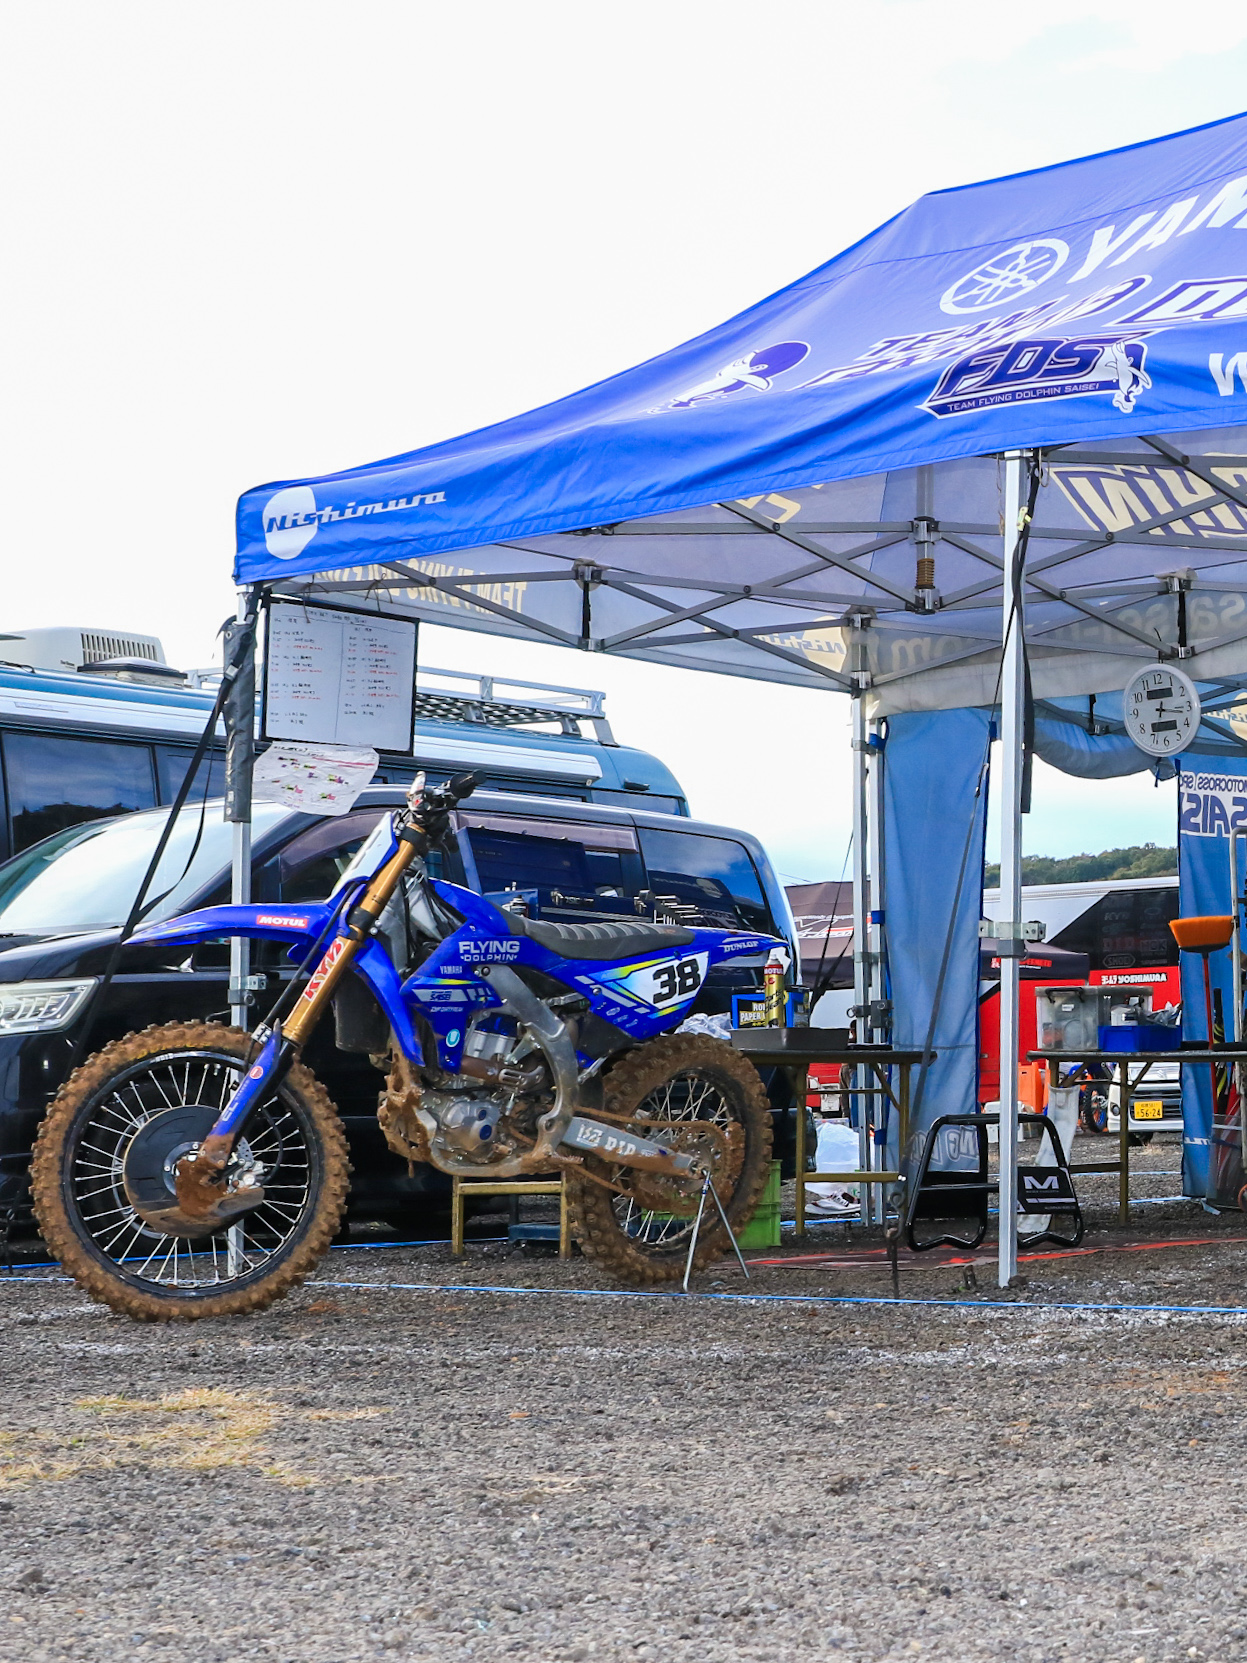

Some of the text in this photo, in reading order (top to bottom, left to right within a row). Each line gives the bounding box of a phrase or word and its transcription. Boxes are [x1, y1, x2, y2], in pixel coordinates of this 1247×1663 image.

[947, 382, 1100, 412] TEAM FLYING DOLPHIN SAISEI
[266, 491, 446, 533] Nishimura
[1153, 674, 1163, 684] 12
[1169, 676, 1173, 686] 1
[1142, 680, 1149, 690] 11
[1179, 686, 1185, 697] 2
[1134, 692, 1143, 703] 10
[1186, 701, 1192, 712] 3
[1133, 708, 1139, 719] 9
[1184, 717, 1190, 727] 4
[1140, 723, 1145, 734] 8
[1150, 733, 1156, 744] 7
[1163, 736, 1170, 746] 6
[1176, 730, 1182, 741] 5
[258, 916, 306, 927] MOTUL
[458, 941, 520, 953] FLYING
[723, 940, 759, 953] DUNLOP
[463, 954, 515, 962] DOLPHIN
[303, 938, 345, 1002] KYB
[653, 958, 701, 1005] 38
[1118, 973, 1168, 984] YOSHIMURA
[740, 1012, 758, 1022] PAPER
